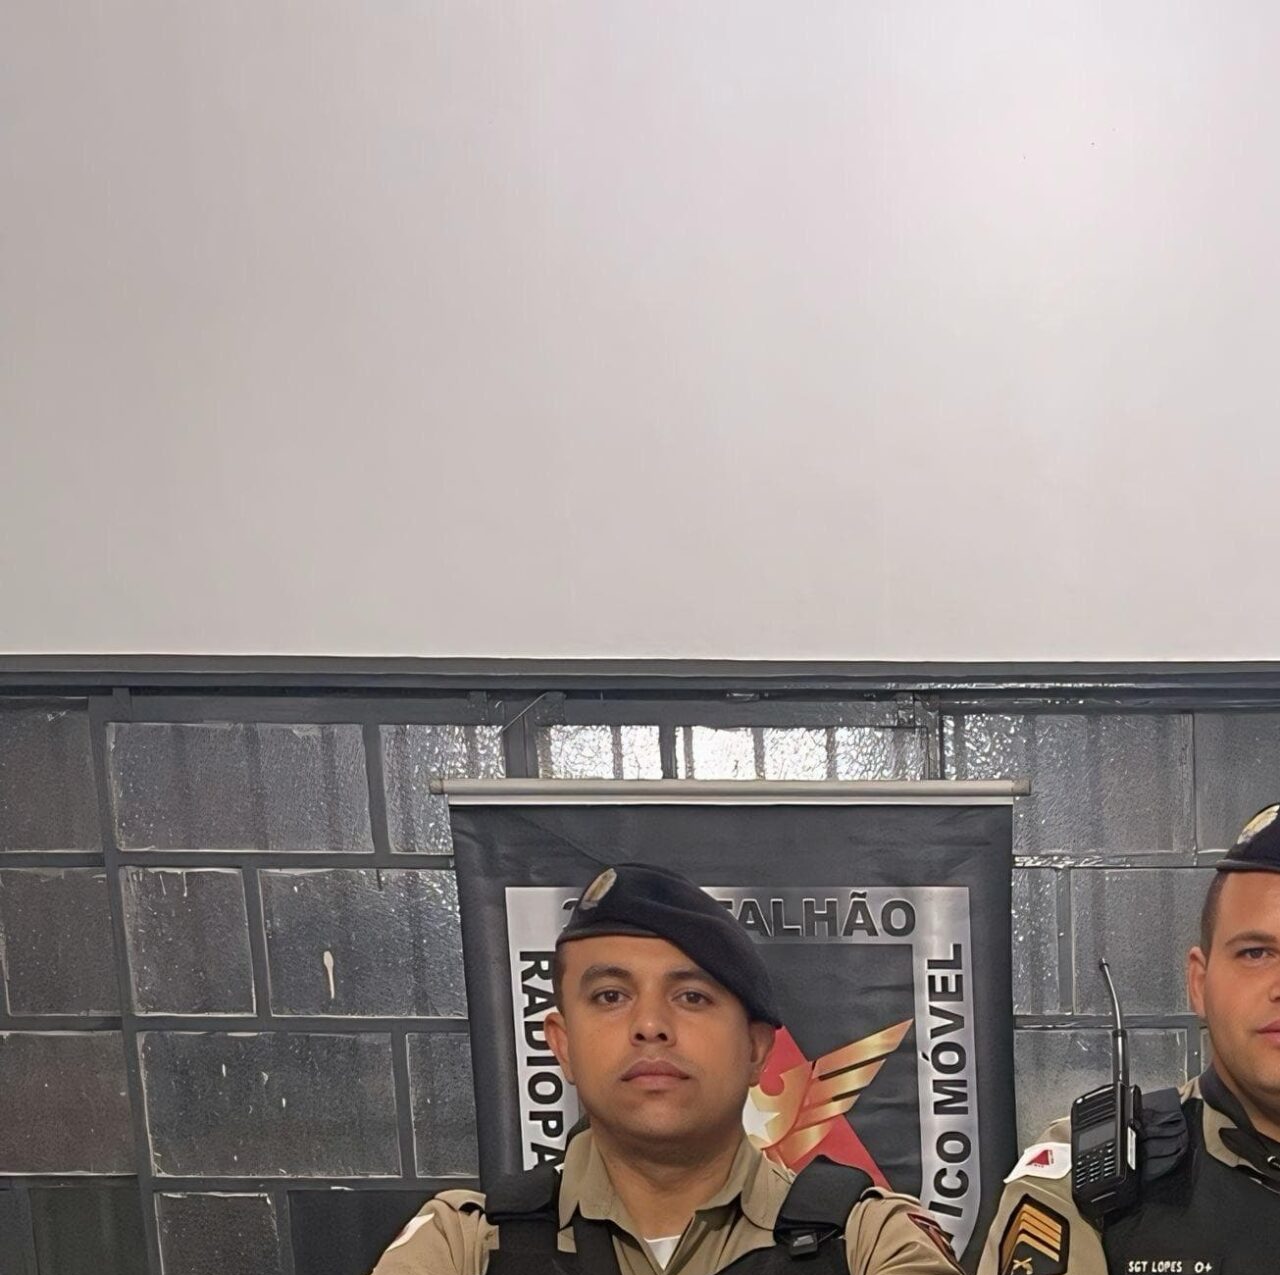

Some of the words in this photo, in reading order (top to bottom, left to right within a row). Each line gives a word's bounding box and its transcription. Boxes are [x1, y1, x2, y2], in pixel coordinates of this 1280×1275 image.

[921, 943, 969, 1116] MÓVEL
[1127, 1260, 1148, 1273] SGT
[1151, 1260, 1183, 1273] LOPES
